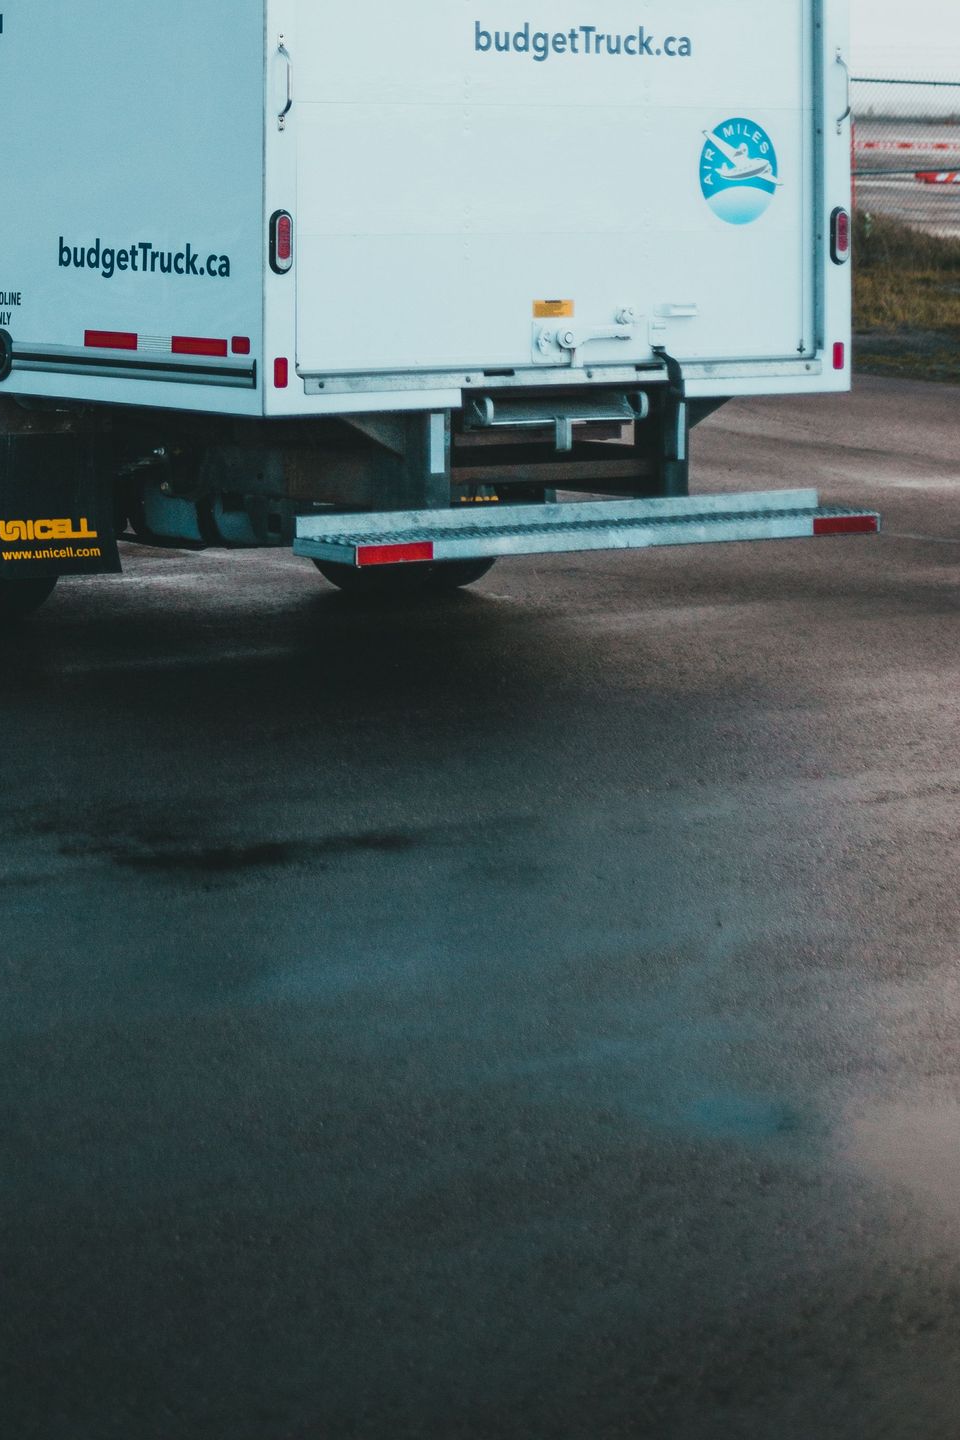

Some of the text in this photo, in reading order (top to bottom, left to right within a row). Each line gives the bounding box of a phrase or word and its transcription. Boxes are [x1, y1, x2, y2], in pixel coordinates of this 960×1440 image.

[474, 20, 692, 62] budgetTruck.ca
[703, 123, 769, 185] AIR MILES
[58, 236, 230, 278] budgetTruck.ca
[2, 546, 101, 560] www.unicell.com
